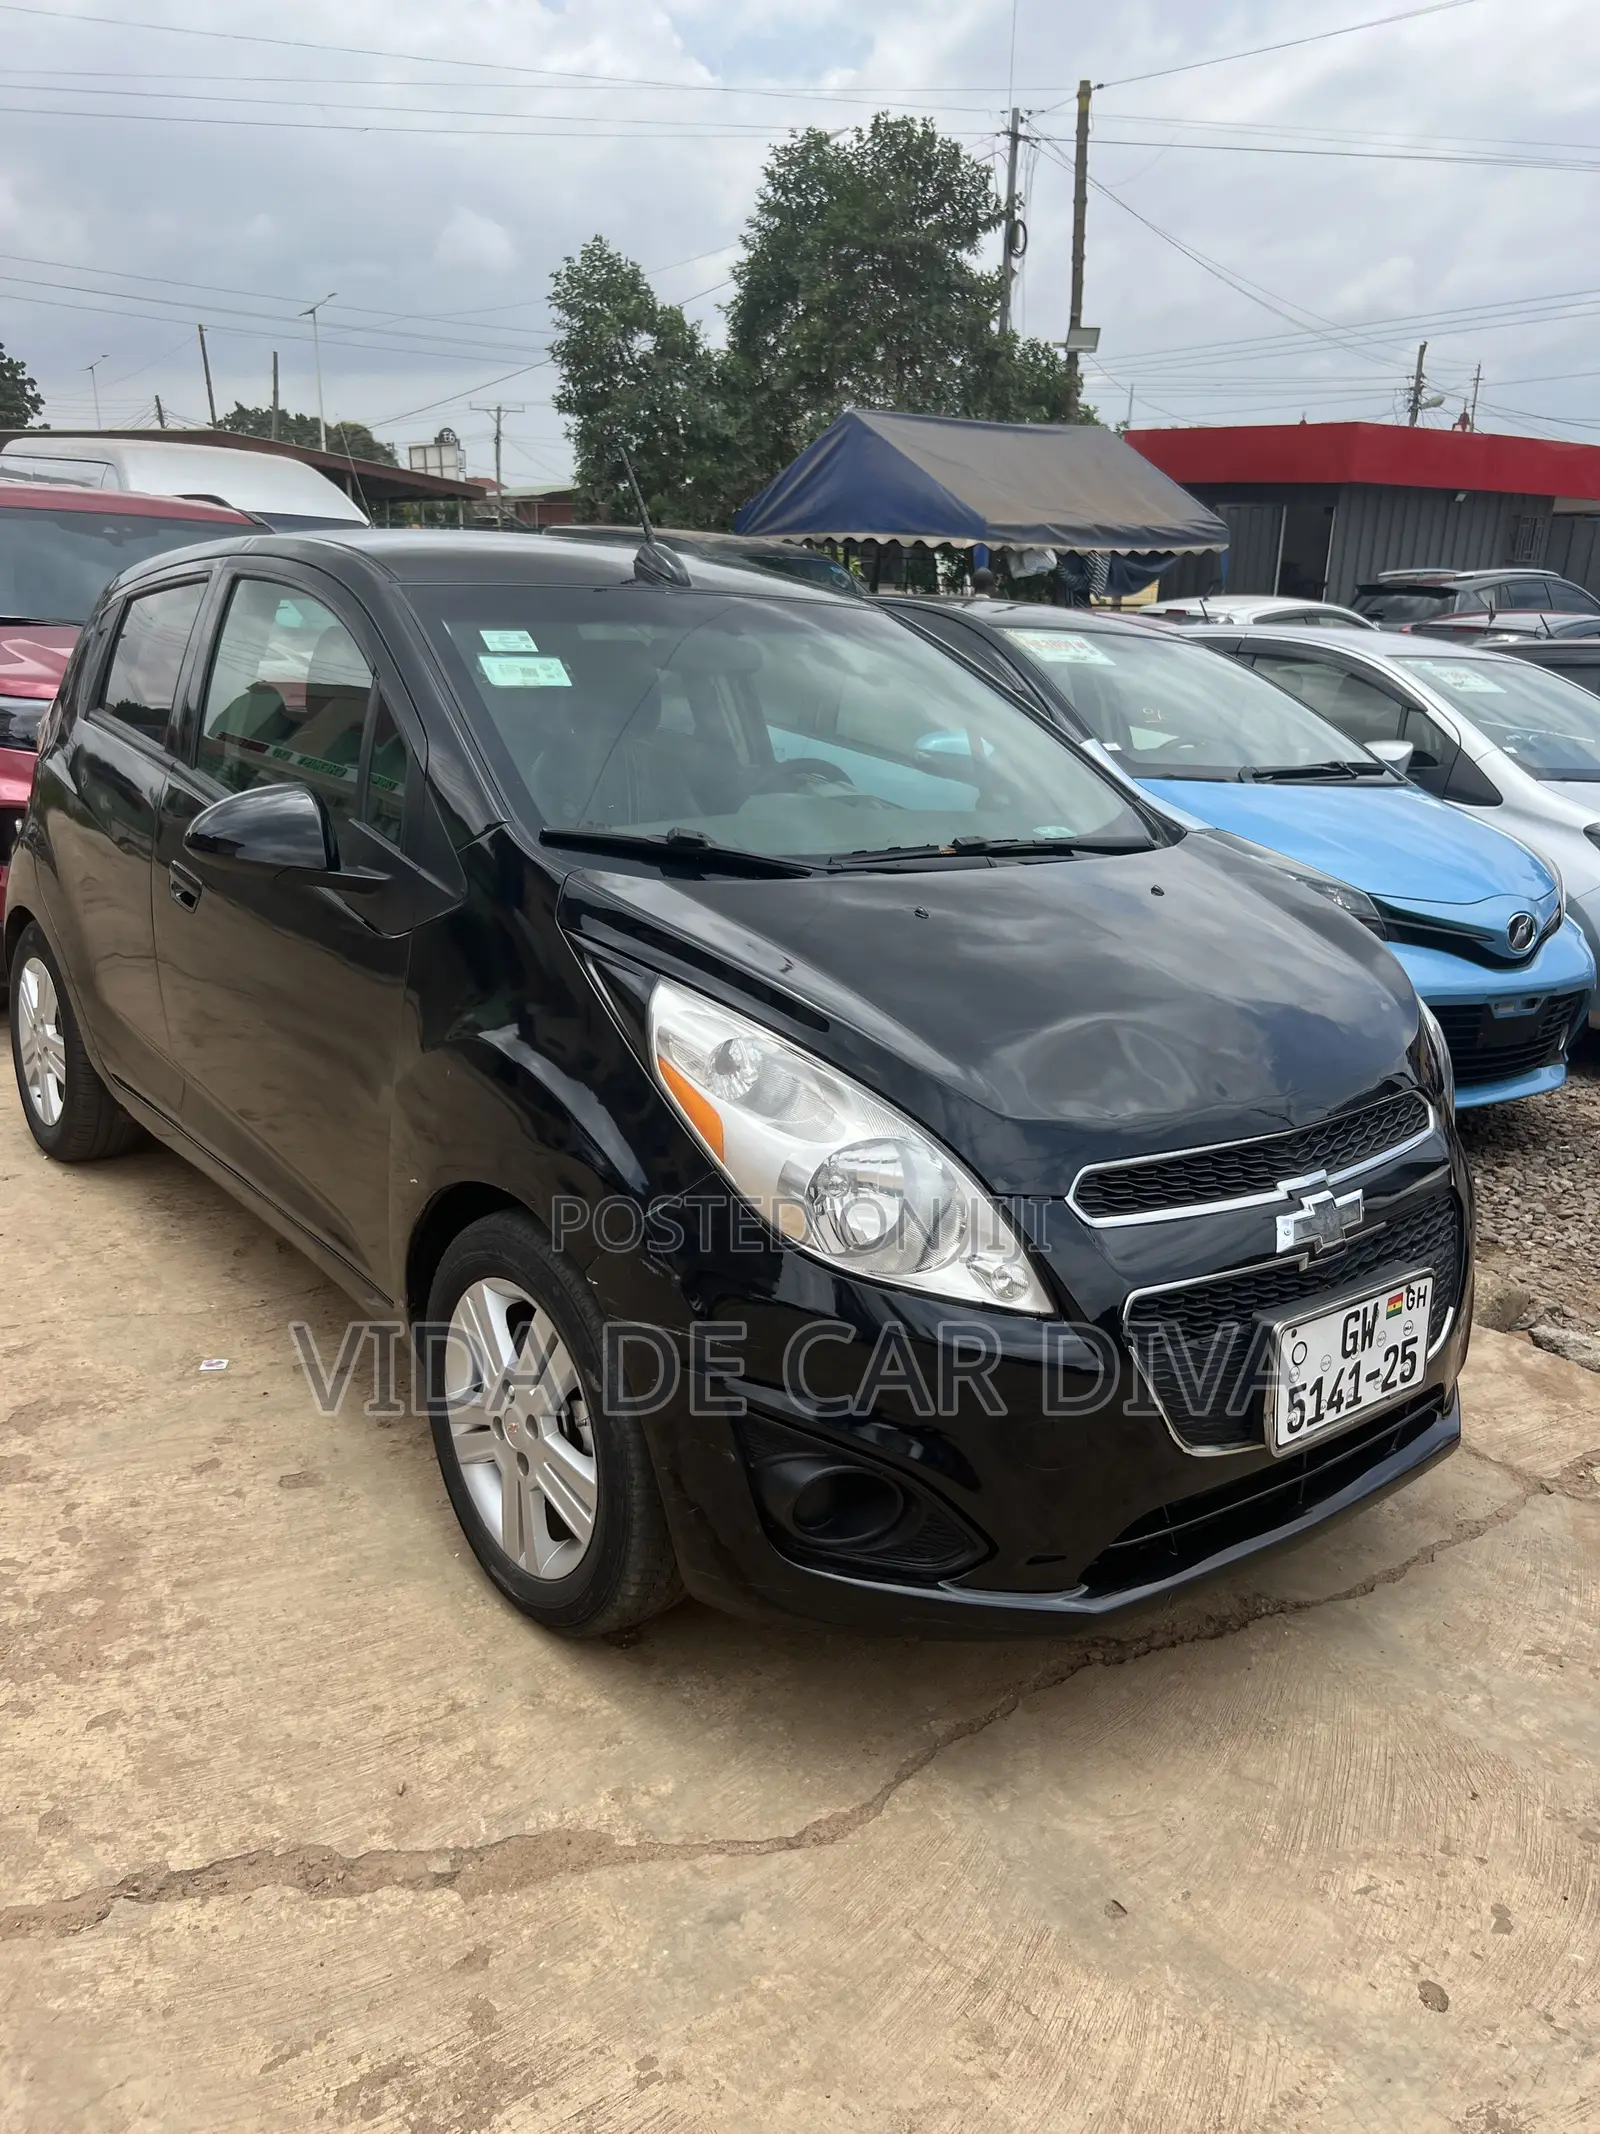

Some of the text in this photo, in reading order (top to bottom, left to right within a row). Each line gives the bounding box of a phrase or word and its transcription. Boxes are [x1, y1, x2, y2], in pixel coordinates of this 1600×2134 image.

[1405, 1285, 1428, 1310] GH
[1341, 1302, 1379, 1360] GW
[1286, 1335, 1419, 1434] 5141-25
